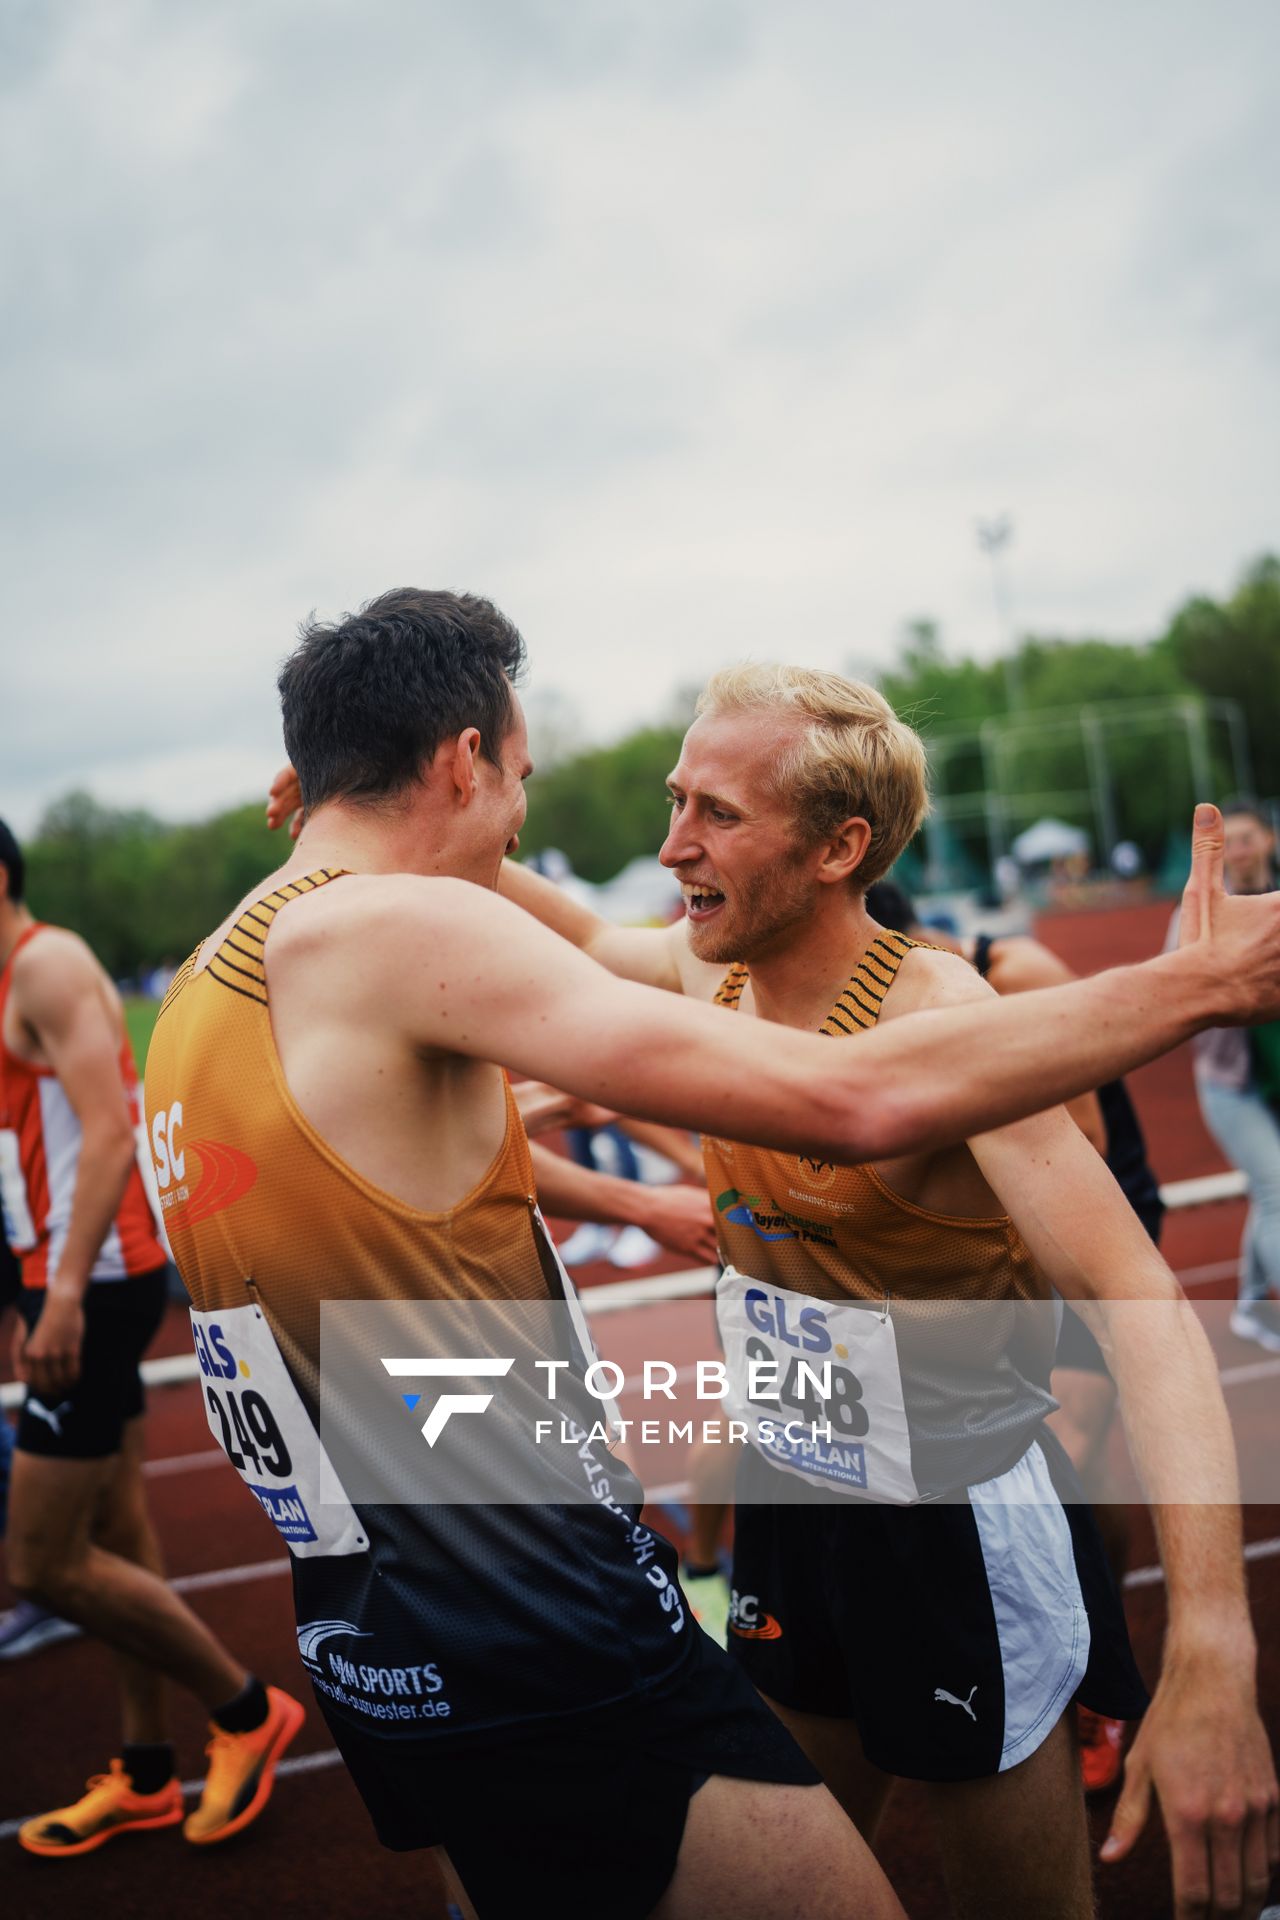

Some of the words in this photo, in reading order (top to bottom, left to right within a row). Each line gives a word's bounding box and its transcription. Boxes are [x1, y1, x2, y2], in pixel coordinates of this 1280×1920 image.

[152, 1101, 185, 1188] SC
[789, 1188, 826, 1208] RUNNING
[746, 1336, 869, 1437] 248
[206, 1385, 293, 1477] 249
[801, 1437, 861, 1472] PLAN
[801, 1460, 862, 1483] INTERNATIONAL
[646, 1565, 685, 1634] LSC
[360, 1663, 443, 1696] SPORTS
